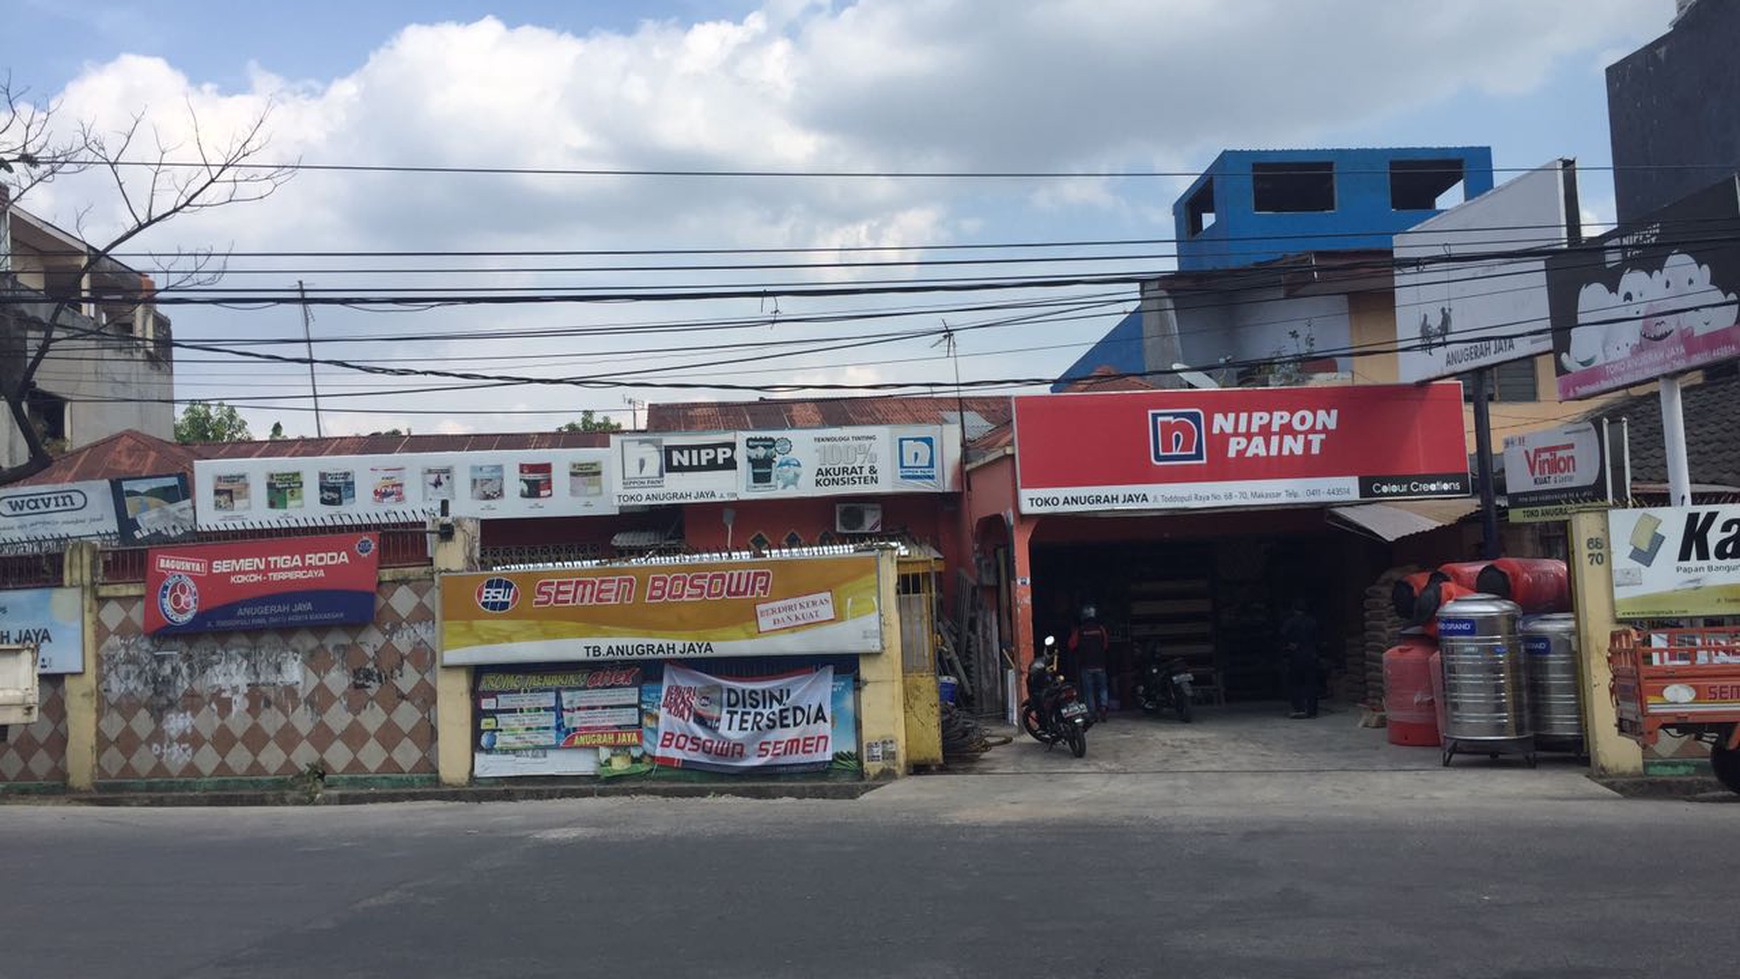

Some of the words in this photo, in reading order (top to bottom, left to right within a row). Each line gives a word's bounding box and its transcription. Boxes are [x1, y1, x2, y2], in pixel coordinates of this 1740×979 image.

[1446, 340, 1491, 367] ANUGERAH
[1493, 338, 1515, 354] JAYA
[1212, 409, 1338, 434] NIPPON
[1227, 434, 1326, 458] PAINT
[672, 448, 737, 466] NIPP
[816, 443, 878, 466] 100%
[1524, 443, 1576, 477] Vinilon
[815, 466, 864, 477] AKURAT
[868, 465, 878, 475] &
[815, 476, 878, 487] KONSISTEN
[1372, 483, 1407, 494] Colour
[1410, 481, 1461, 492] Creations
[7, 494, 76, 512] wavin
[617, 494, 643, 502] TOKO
[645, 492, 692, 501] ANUGRAH
[694, 491, 716, 500] JAYA
[1028, 497, 1059, 507] TOKO
[1062, 495, 1119, 506] ANUGRAH
[1121, 493, 1149, 504] JAYA
[1250, 491, 1282, 499] Makassar
[1523, 509, 1539, 518] TOKO
[1586, 537, 1604, 549] 68
[160, 558, 205, 572] BAGUSNYA!
[212, 557, 265, 574] SEMEN
[268, 554, 302, 569] TIGA
[305, 551, 349, 567] RODA
[1587, 553, 1604, 566] 70
[230, 574, 262, 584] KOKOH
[267, 569, 325, 581] TERPERCAYA
[1676, 565, 1705, 574] Papan
[533, 576, 636, 607] SEMEN
[646, 569, 772, 603] BOSOWA
[237, 604, 289, 616] ANUGERAH
[292, 602, 313, 612] JAYA
[760, 605, 797, 618] BERDIRI
[799, 598, 829, 610] KERAS
[14, 628, 52, 643] JAYA
[678, 642, 714, 654] JAYA
[726, 702, 828, 731] TERSEDIA
[574, 733, 614, 745] ANUGRAH
[618, 732, 638, 745] JAYA
[660, 731, 745, 758] BOSOWA
[757, 735, 829, 758] SEMEN
